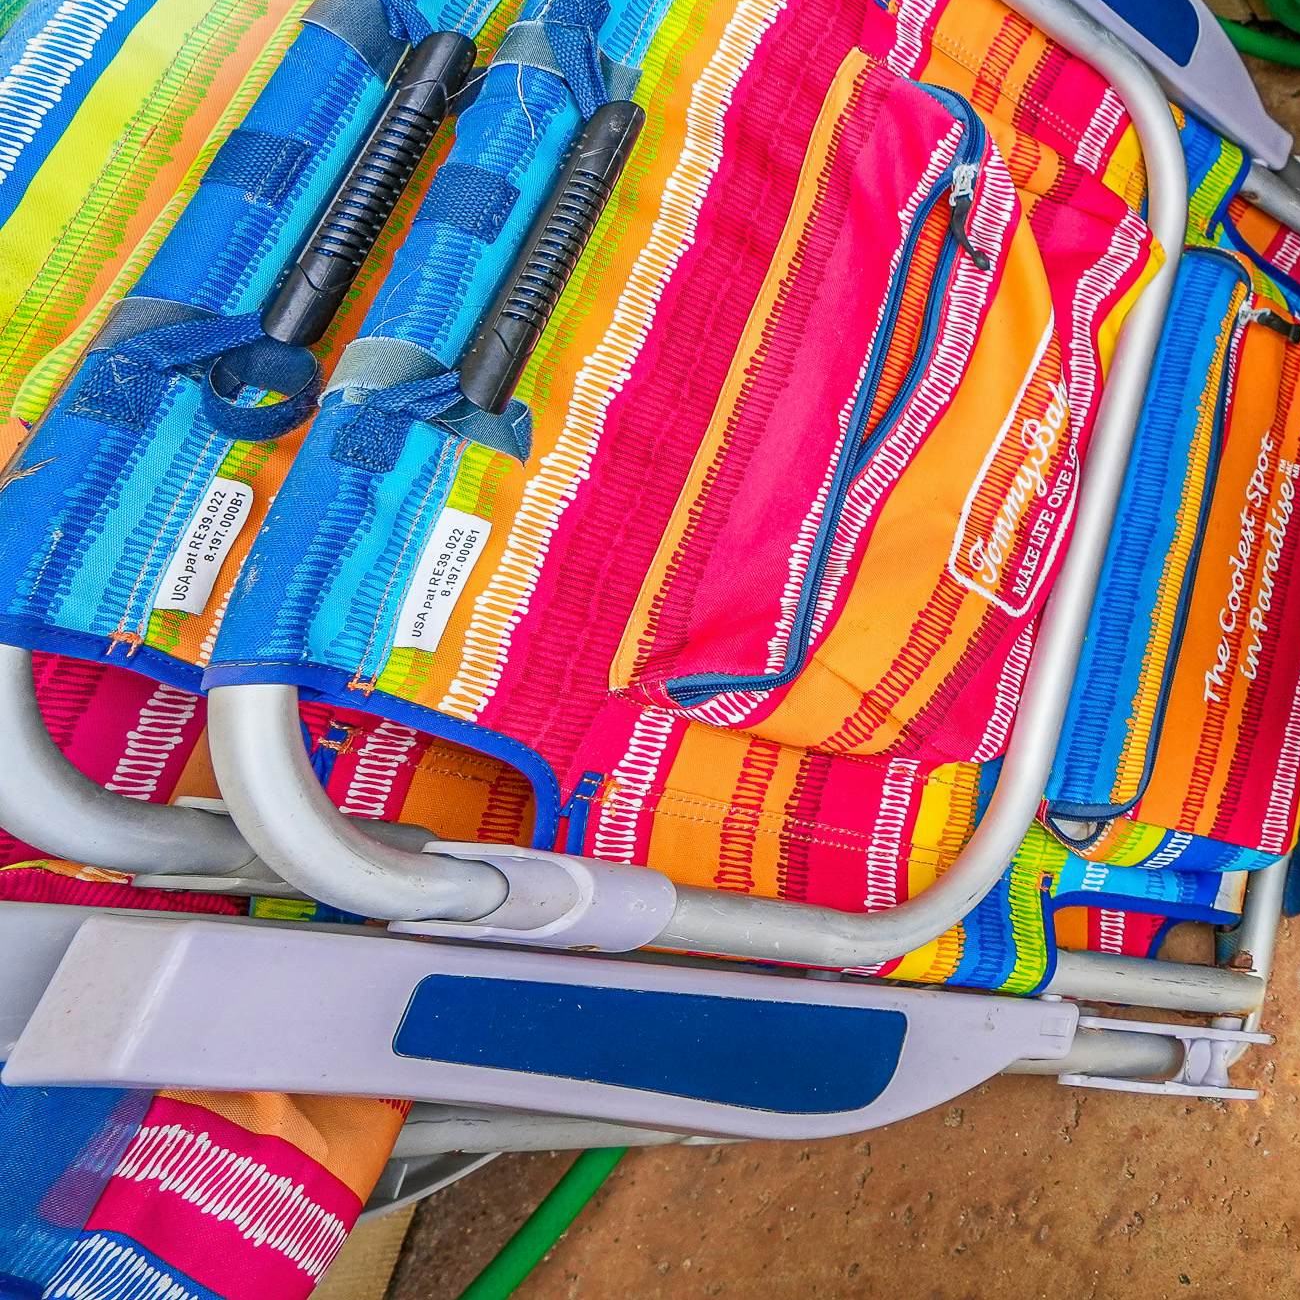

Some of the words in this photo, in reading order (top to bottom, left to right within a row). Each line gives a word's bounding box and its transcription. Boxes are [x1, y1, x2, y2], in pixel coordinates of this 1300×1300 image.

[203, 490, 247, 563] 8.197.000B1
[968, 456, 1048, 584] Tommy
[1011, 543, 1041, 599] MAKE
[1029, 508, 1056, 552] LIFE
[1046, 469, 1073, 509] ONE
[1249, 475, 1296, 632] Paradise
[170, 574, 193, 602] USA
[184, 551, 198, 575] pat
[440, 528, 481, 598] 8.197.000B1
[1204, 634, 1231, 703] The
[1218, 504, 1256, 634] Coolest
[1246, 430, 1274, 507] Spot
[411, 611, 429, 638] USA
[1240, 633, 1264, 681] in
